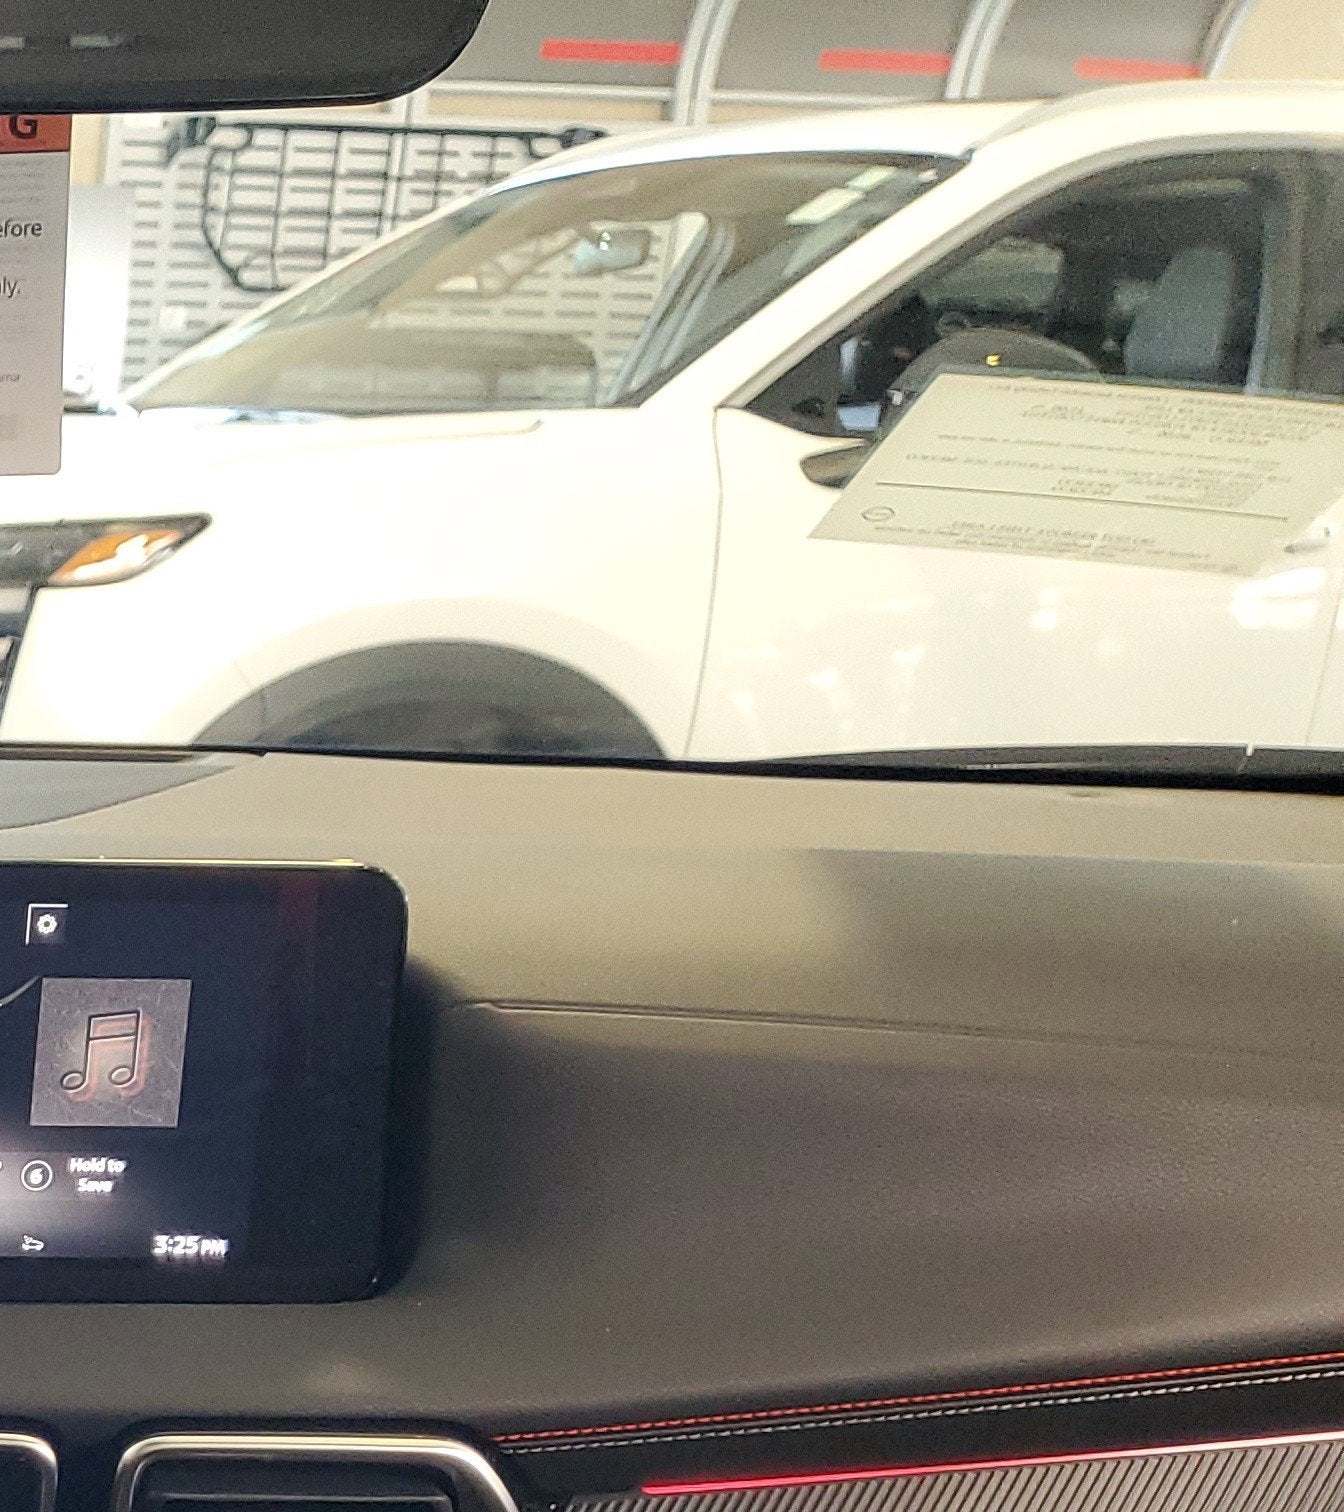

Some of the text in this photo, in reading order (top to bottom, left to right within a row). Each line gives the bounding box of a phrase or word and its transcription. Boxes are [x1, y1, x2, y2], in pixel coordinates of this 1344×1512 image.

[69, 1157, 125, 1173] Hold to
[29, 1168, 43, 1185] 6
[78, 1178, 113, 1192] Save
[153, 1235, 228, 1257] 3:25 PM
